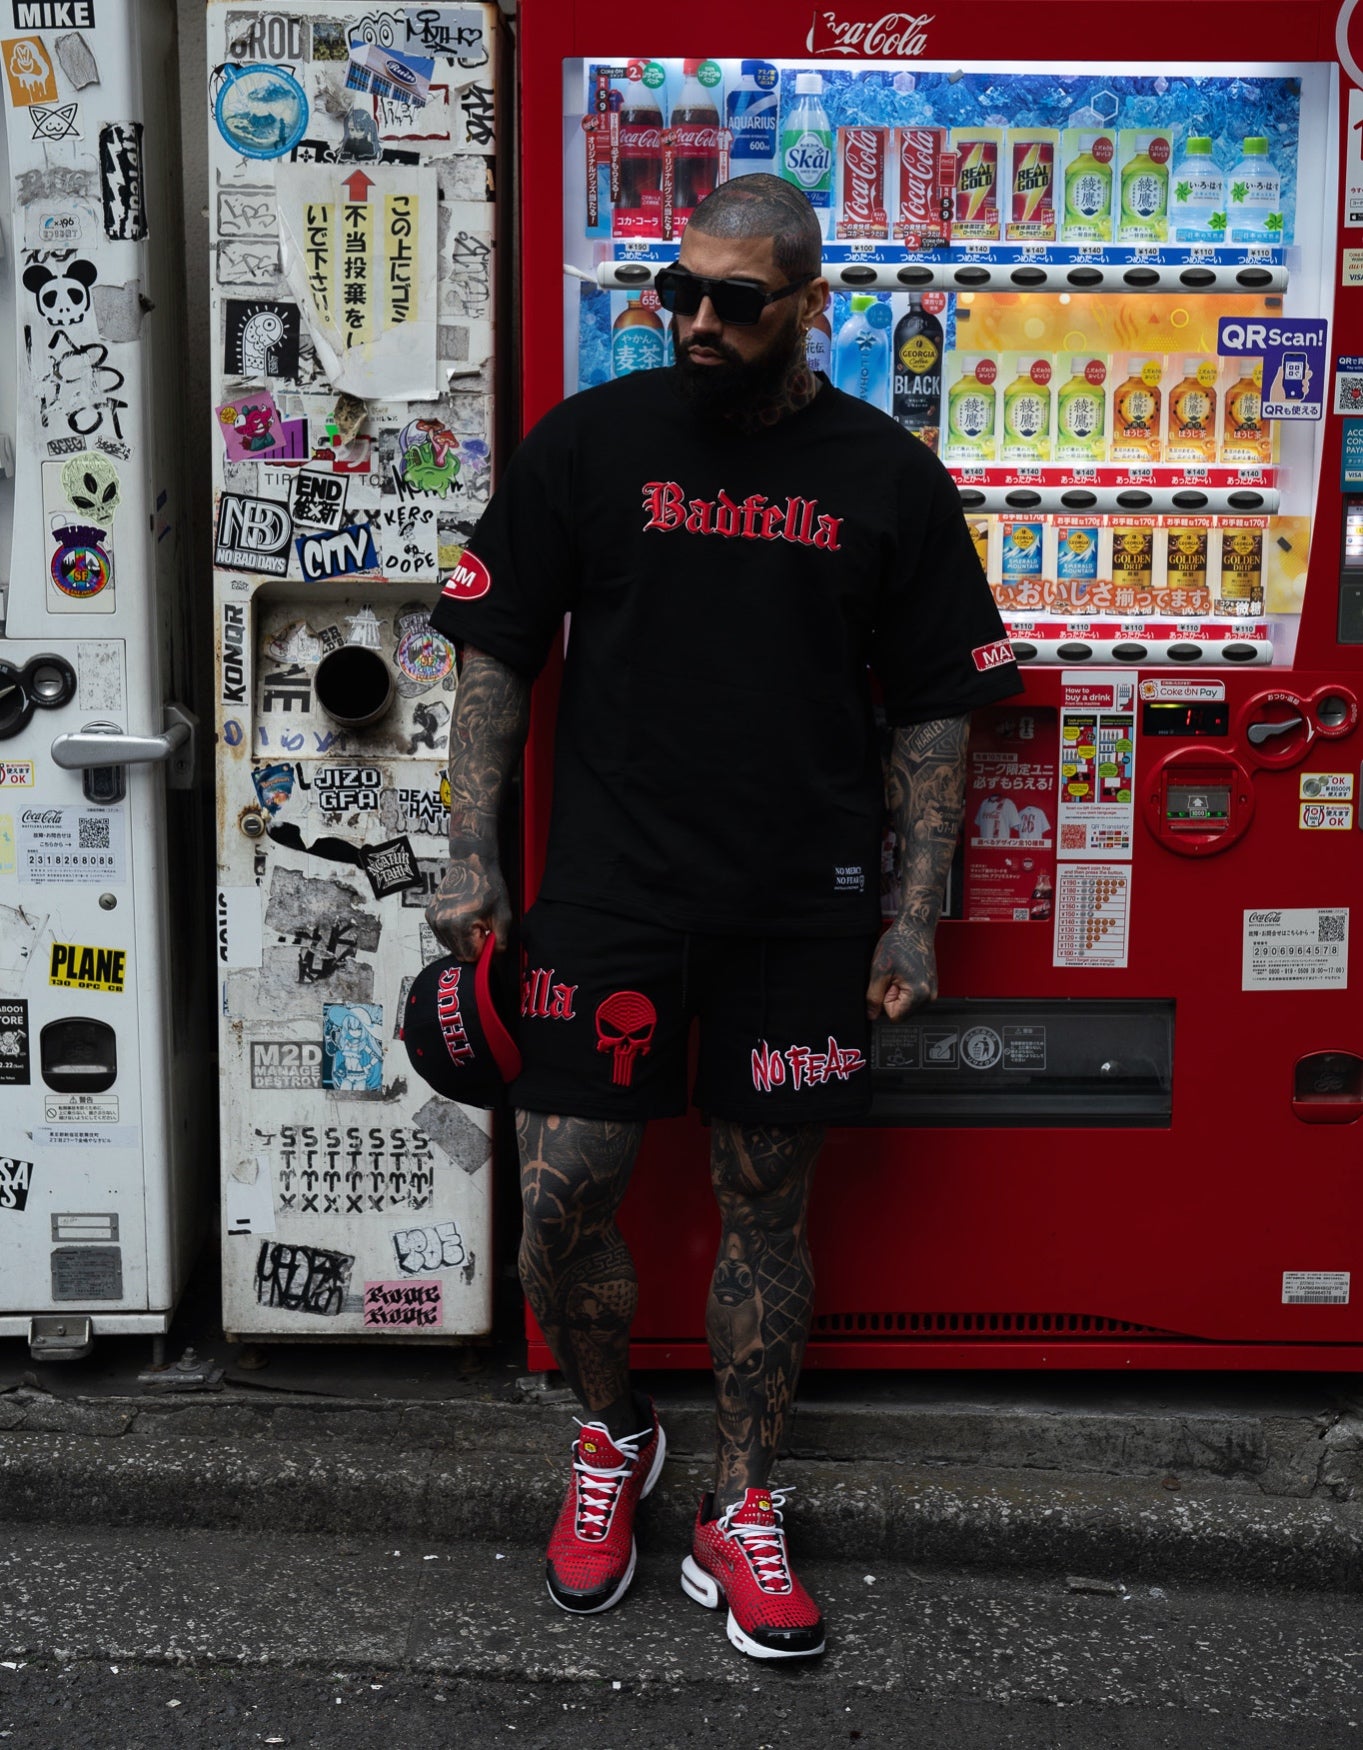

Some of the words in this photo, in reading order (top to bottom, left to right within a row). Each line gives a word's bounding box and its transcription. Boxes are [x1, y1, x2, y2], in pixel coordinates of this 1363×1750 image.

[17, 2, 91, 28] MIKE
[728, 116, 776, 130] AQUARIUS
[960, 163, 992, 180] REAL
[1017, 163, 1049, 181] REAL
[961, 175, 992, 191] GOLD
[1017, 176, 1049, 192] GOLD
[1080, 176, 1097, 207] 綾鷹
[1137, 177, 1153, 208] 綾鷹
[617, 217, 659, 226] コカ・コーラ
[390, 196, 412, 323] この上にゴミ
[1222, 325, 1267, 350] QR
[1268, 329, 1324, 347] Scan!
[615, 345, 661, 371] 麦茶
[902, 350, 936, 358] GEORGIA
[894, 375, 941, 395] BLACK
[964, 397, 981, 428] 綾鷹
[1019, 397, 1035, 428] 綾鷹
[1073, 397, 1089, 428] 綾鷹
[1264, 404, 1318, 416] QRも使える
[296, 475, 342, 501] END
[384, 506, 434, 526] KERS
[642, 481, 844, 552] Badfella
[215, 549, 232, 563] NO
[232, 551, 258, 566] BAD
[258, 554, 287, 572] DAYS
[303, 528, 369, 579] CITY
[1113, 553, 1151, 564] GOLDEN
[1168, 553, 1205, 564] GOLDEN
[1223, 554, 1260, 565] GOLDEN
[386, 553, 436, 573] DOPE
[73, 570, 89, 581] SF
[223, 603, 246, 703] KONQR
[1065, 694, 1081, 703] buy
[1089, 694, 1111, 702] drink
[1160, 688, 1183, 696] Coke
[1199, 688, 1218, 699] Pay
[10, 775, 27, 784] OK
[314, 768, 381, 789] JIZO
[972, 777, 1053, 790] 必ずもらえる!
[1332, 777, 1346, 785] OK
[319, 790, 379, 812] GFA
[22, 810, 64, 825] Coca-Cola
[1328, 817, 1344, 826] OK
[29, 856, 114, 866] 2318268088
[1248, 912, 1282, 924] Coca-Cola
[1254, 947, 1338, 956] 2906964578
[51, 944, 126, 984] PLANE
[51, 979, 71, 987] 130
[437, 966, 475, 1069] THUG
[254, 1044, 323, 1066] M2D
[254, 1065, 321, 1077] MANAGE
[751, 1039, 786, 1092] NO
[254, 1076, 321, 1088] DESTROY
